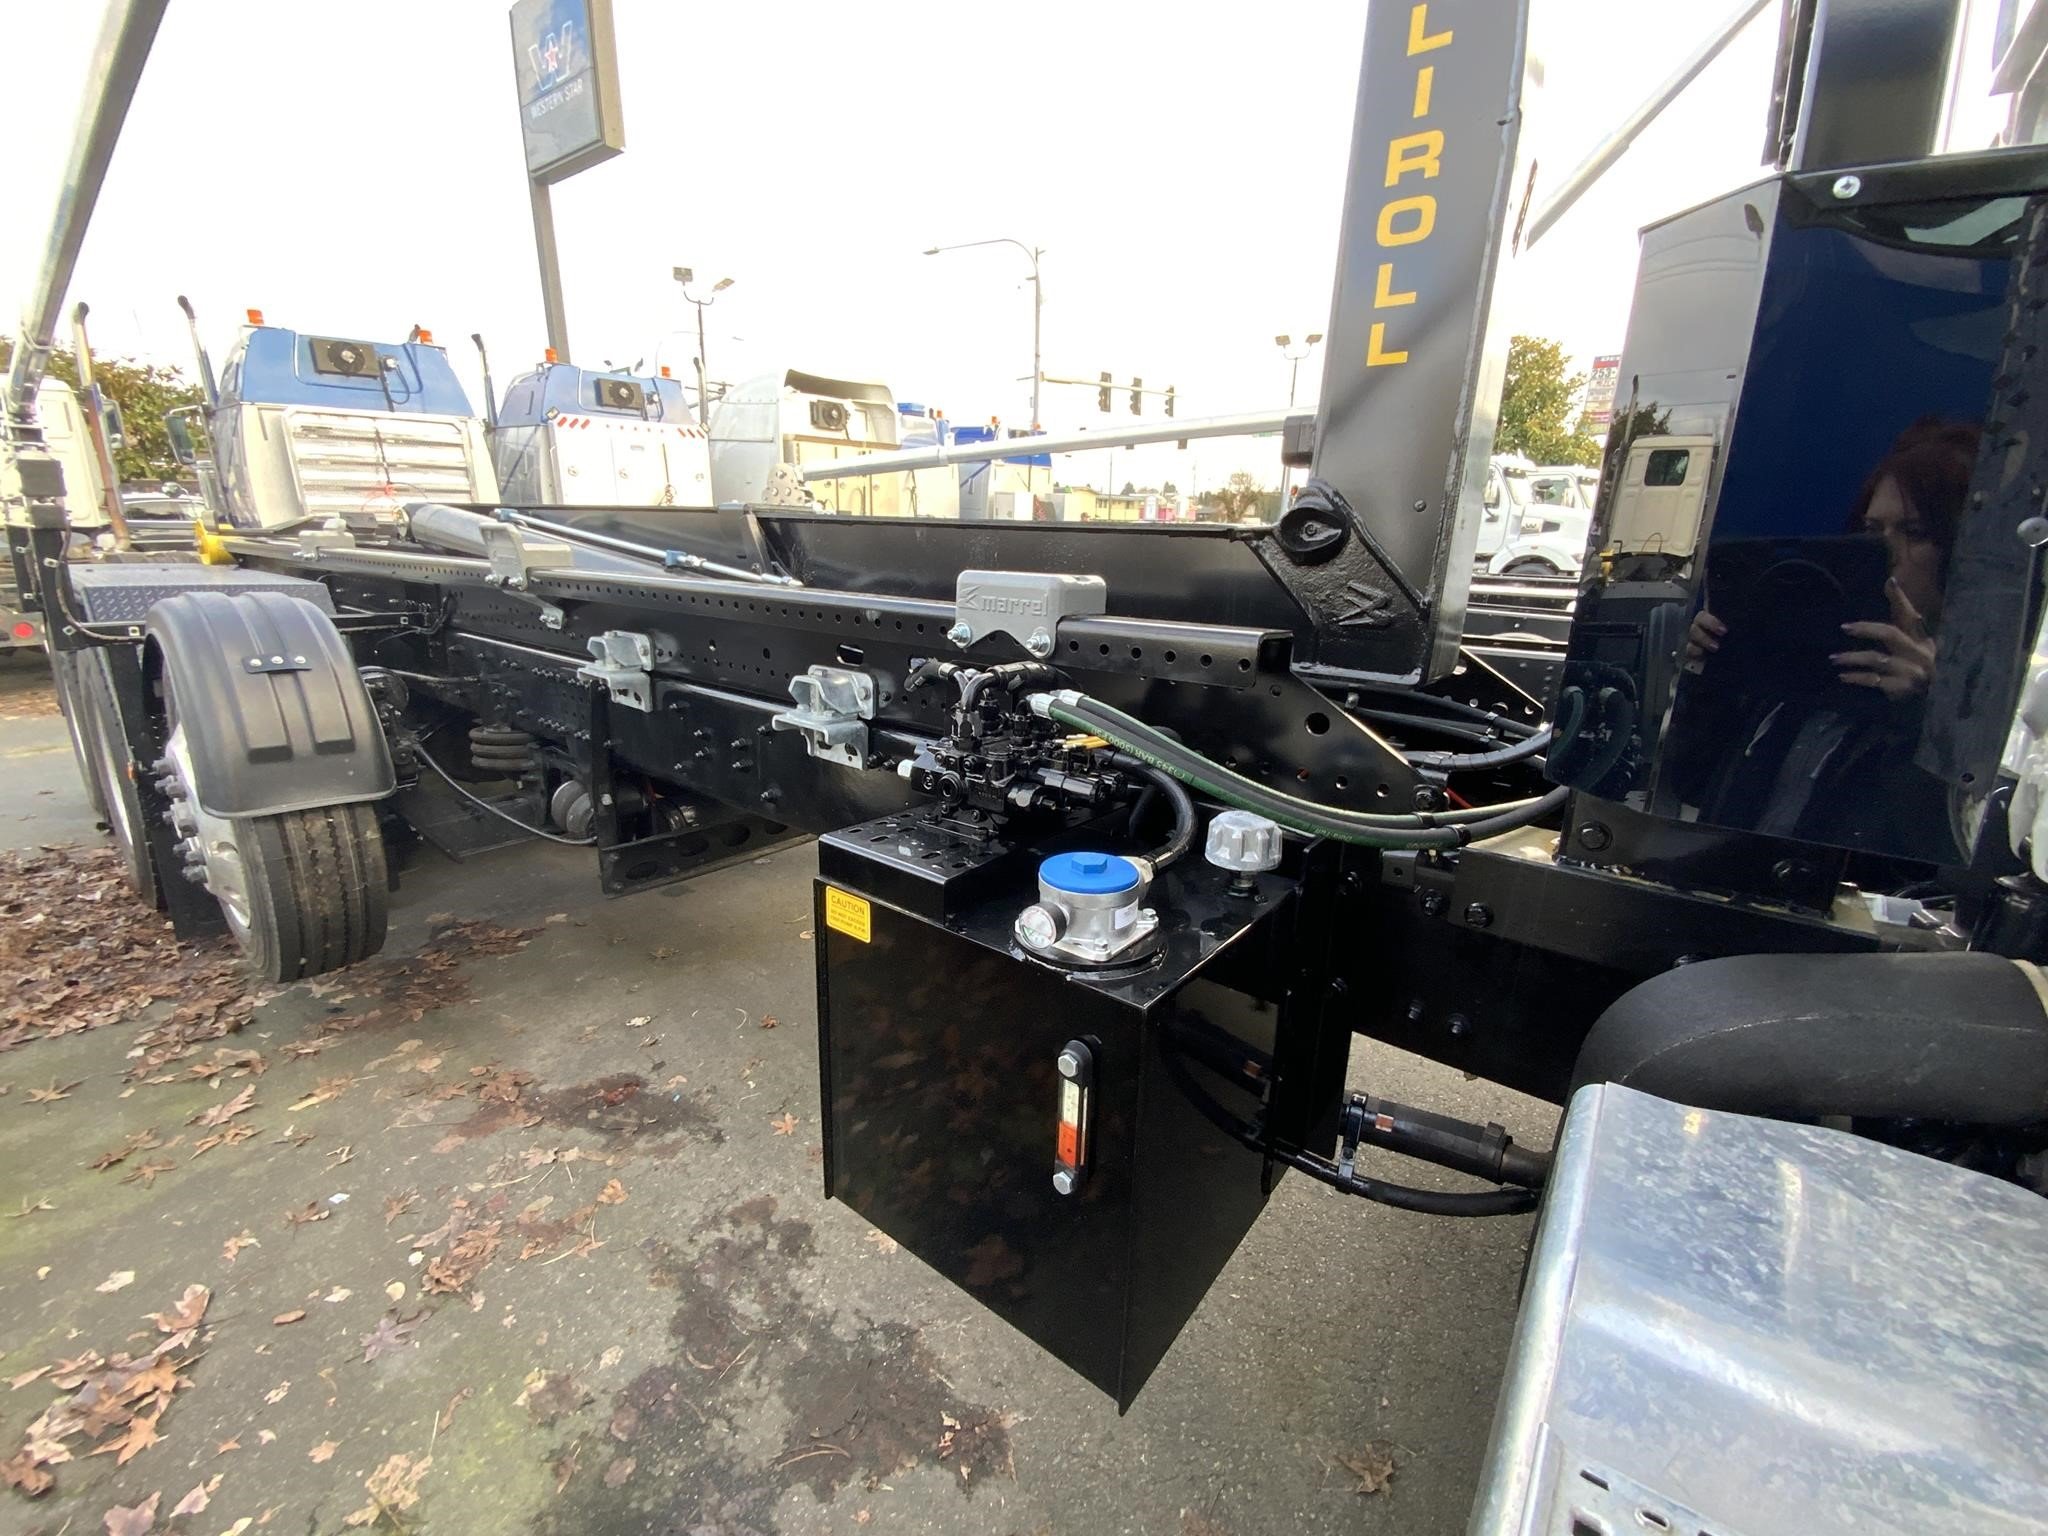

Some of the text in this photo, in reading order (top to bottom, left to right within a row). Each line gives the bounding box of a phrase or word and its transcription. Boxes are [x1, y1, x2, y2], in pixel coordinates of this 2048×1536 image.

[530, 78, 583, 119] WESTERN STAR
[981, 591, 1049, 616] marrel
[1135, 749, 1155, 764] BAR
[831, 895, 865, 916] CAUTION
